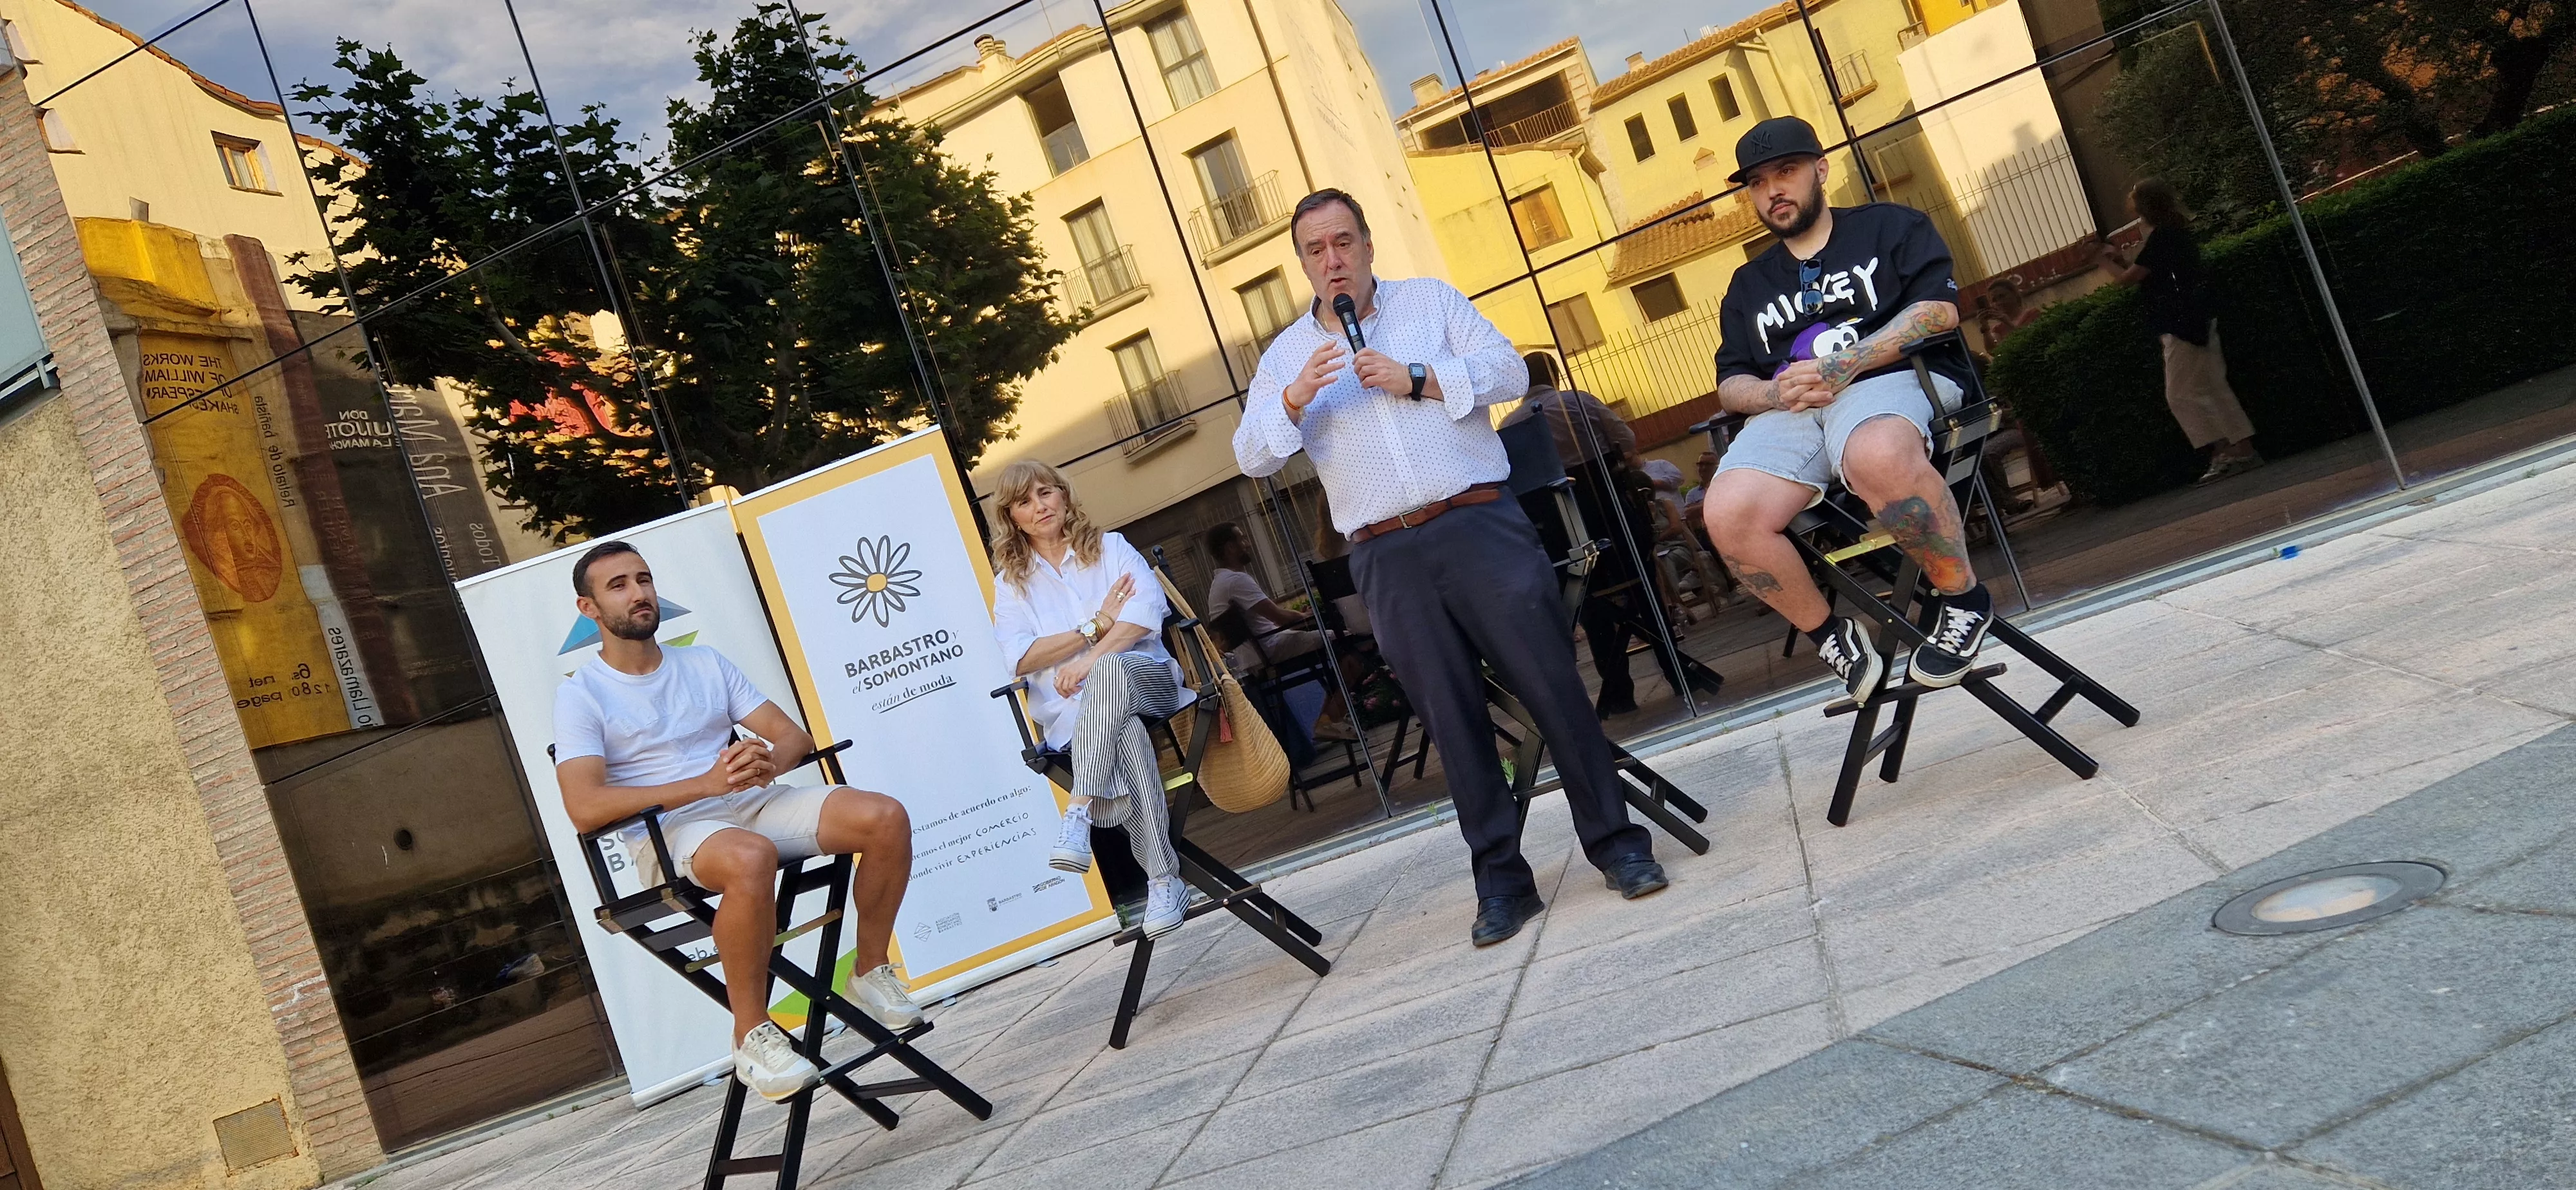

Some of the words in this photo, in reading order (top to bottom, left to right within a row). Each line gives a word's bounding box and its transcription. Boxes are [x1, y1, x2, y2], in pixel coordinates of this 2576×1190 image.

[844, 629, 949, 678] BARBASTRO
[952, 630, 959, 643] y
[852, 681, 862, 694] el
[863, 645, 963, 690] SOMONTANO
[871, 694, 900, 711] están
[903, 687, 918, 699] de
[920, 674, 953, 694] moda
[913, 817, 947, 835] estamos
[949, 811, 960, 820] de
[961, 798, 996, 816] acuerdo
[998, 794, 1009, 802] en
[1010, 785, 1032, 798] algo:
[939, 841, 946, 850] el
[947, 833, 972, 847] mejor
[934, 860, 953, 871] vivir
